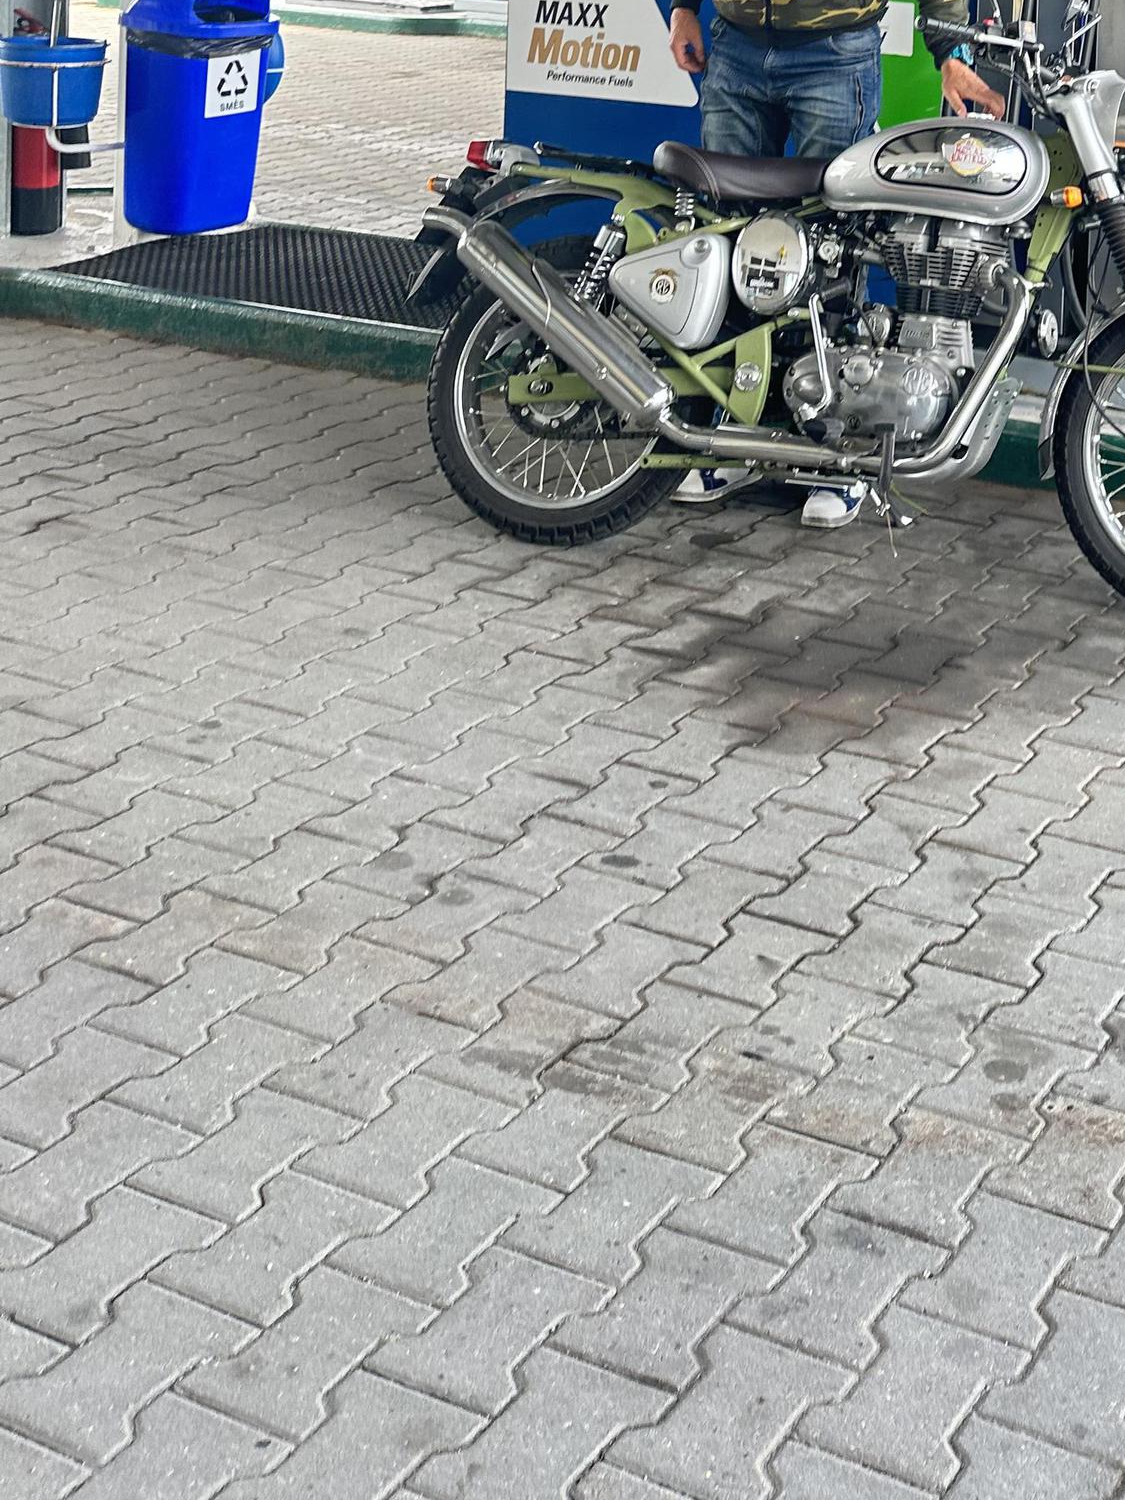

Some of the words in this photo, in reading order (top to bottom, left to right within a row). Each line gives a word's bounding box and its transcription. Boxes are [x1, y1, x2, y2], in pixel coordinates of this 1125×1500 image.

[535, 0, 609, 28] MAXX
[527, 27, 641, 72] Motion
[546, 70, 606, 85] Performance
[607, 75, 634, 88] Fuels
